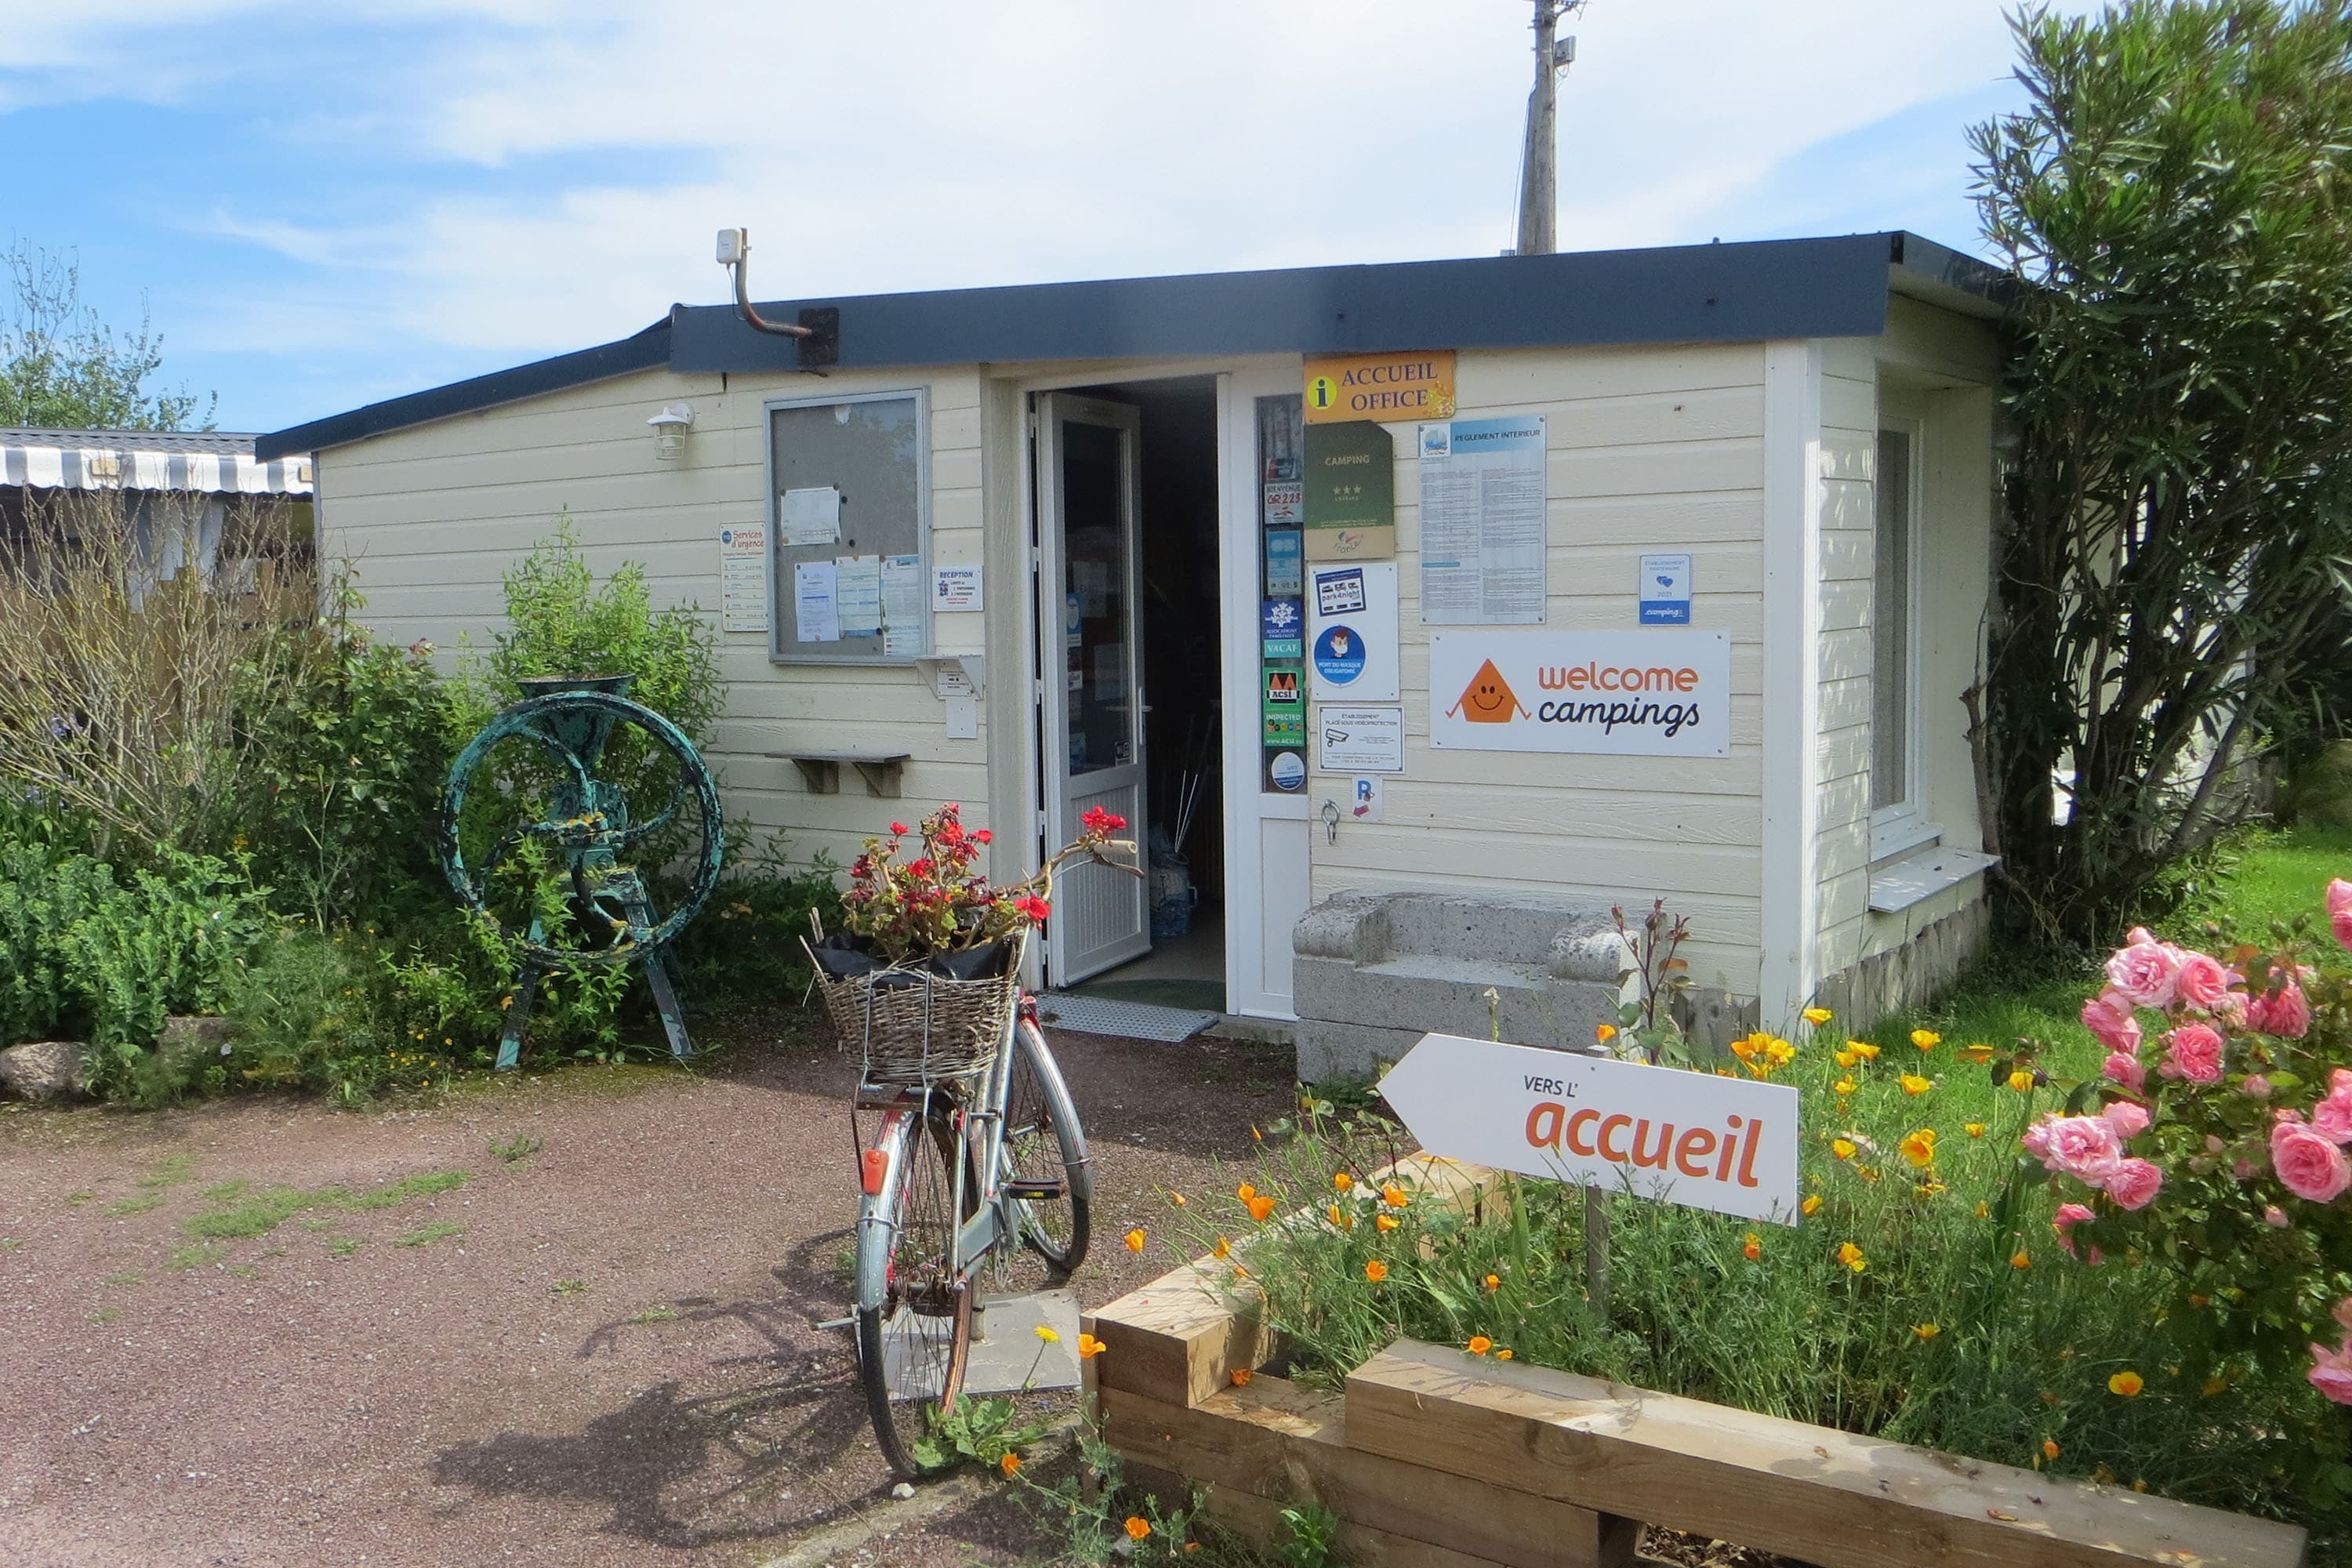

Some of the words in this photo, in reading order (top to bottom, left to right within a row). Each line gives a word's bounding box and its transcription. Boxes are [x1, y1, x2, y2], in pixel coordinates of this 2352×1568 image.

[1341, 363, 1438, 387] ACCUEIL
[1352, 390, 1428, 411] OFFICE
[1325, 455, 1370, 466] CAMPING
[731, 540, 765, 550] d'urgence
[733, 530, 763, 539] Services
[1322, 590, 1360, 602] park4night
[1267, 644, 1298, 652] VACAF
[1538, 661, 1699, 692] welcome
[1538, 696, 1700, 738] campings
[1523, 1075, 1564, 1095] VERS
[1566, 1082, 1578, 1098] L'
[1526, 1102, 1762, 1188] accueil
